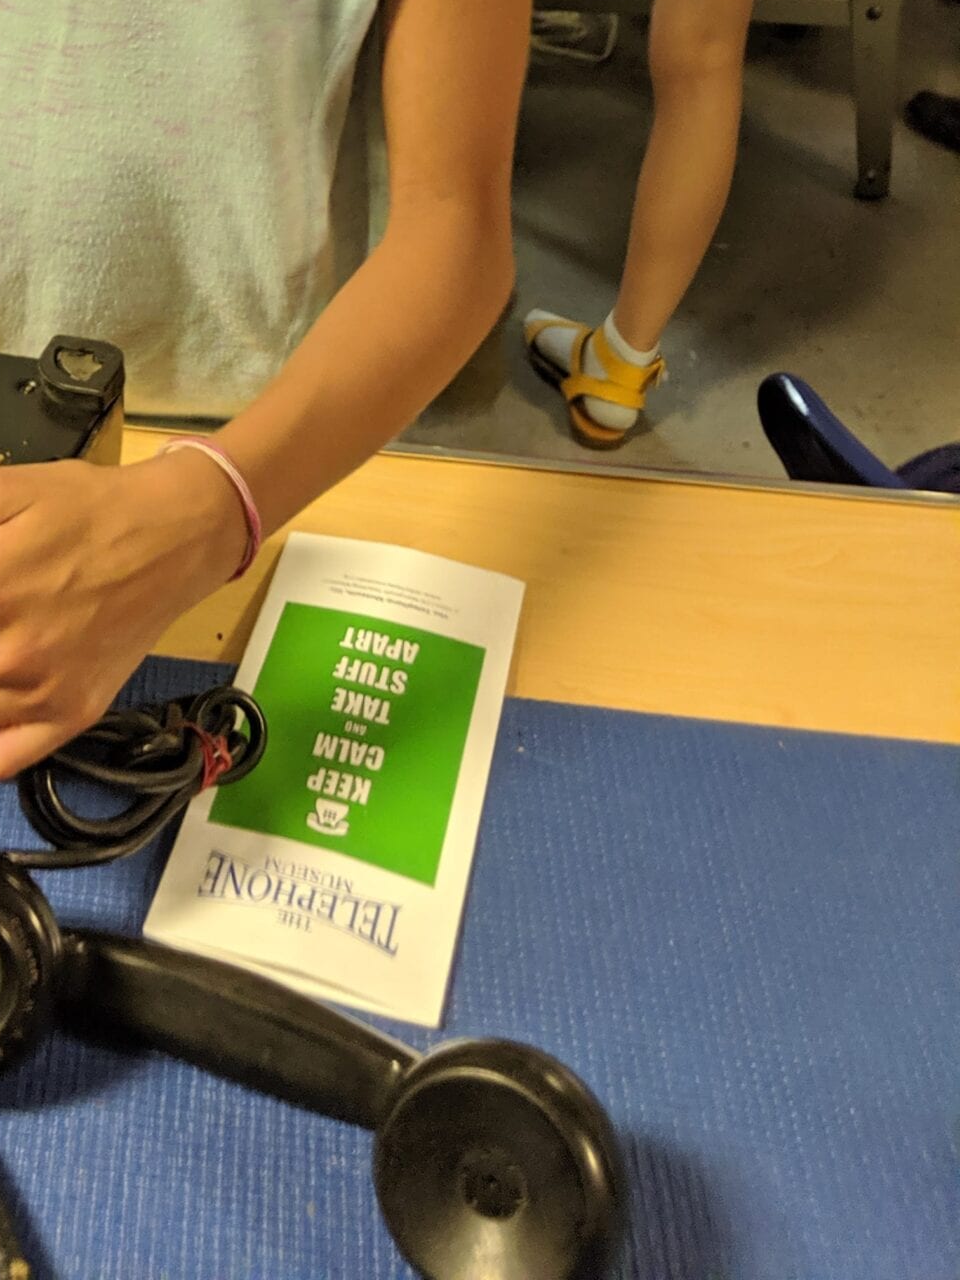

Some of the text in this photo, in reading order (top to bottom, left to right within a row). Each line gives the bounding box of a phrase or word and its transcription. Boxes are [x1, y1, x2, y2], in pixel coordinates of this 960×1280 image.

[339, 626, 420, 665] APART
[332, 656, 408, 695] STUFF
[331, 687, 390, 725] TAKE
[345, 721, 367, 736] AND
[312, 731, 385, 771] CALM
[306, 767, 372, 806] KEEP
[265, 855, 353, 894] MUSEUM
[197, 849, 402, 956] TELEPHONE
[278, 909, 312, 933] THE
